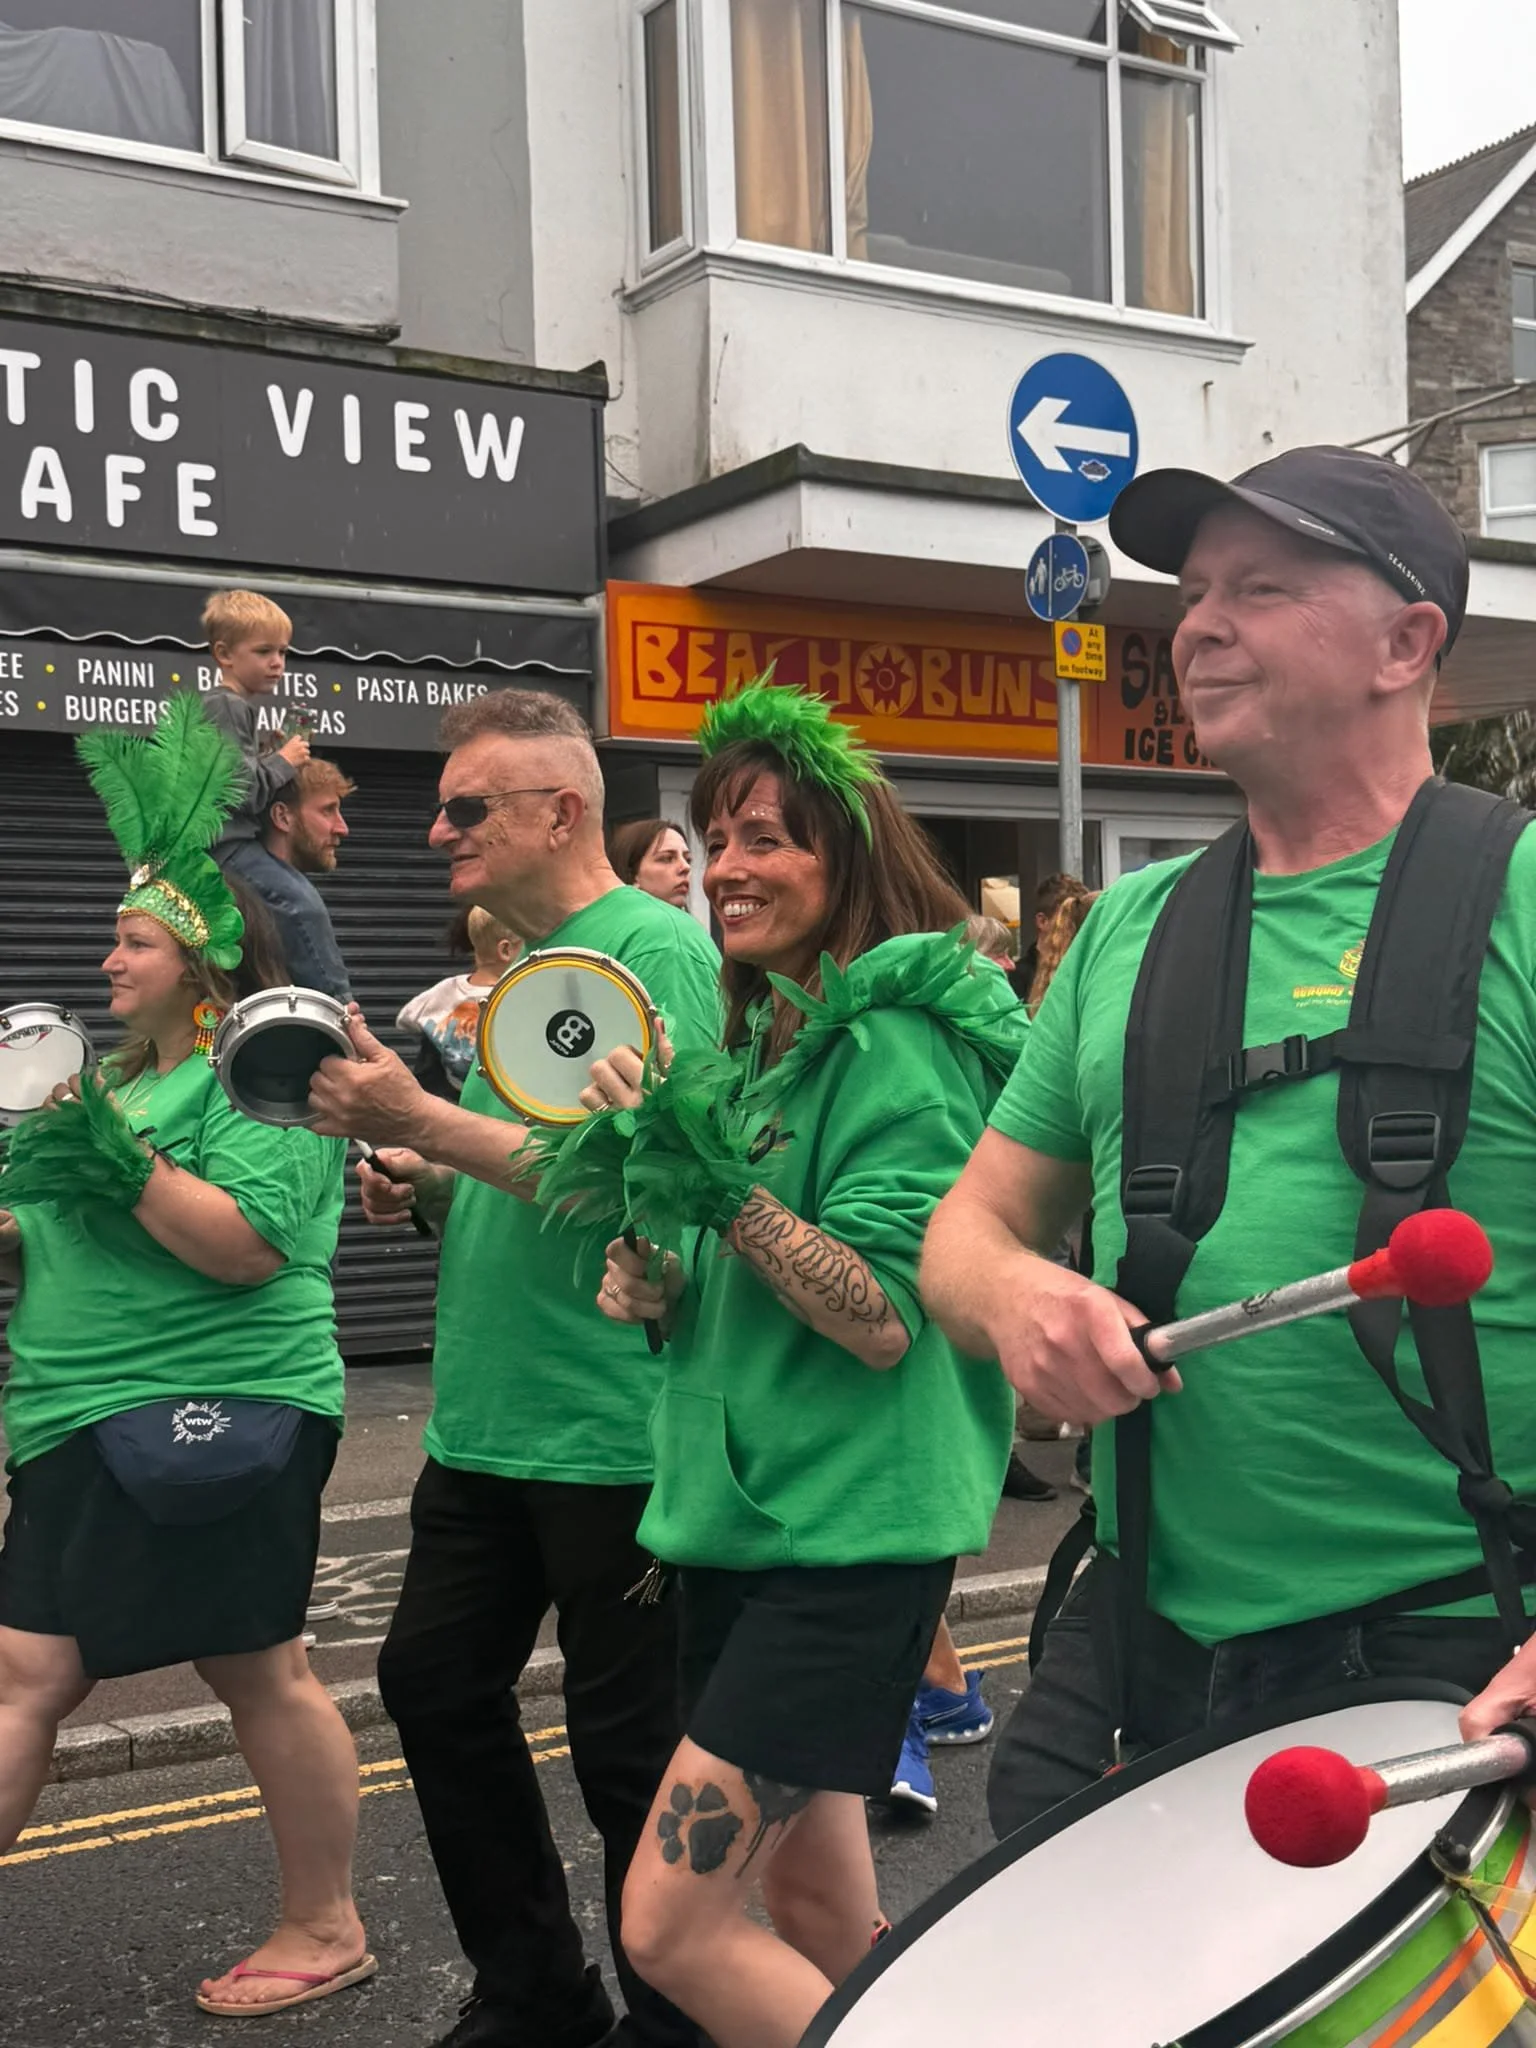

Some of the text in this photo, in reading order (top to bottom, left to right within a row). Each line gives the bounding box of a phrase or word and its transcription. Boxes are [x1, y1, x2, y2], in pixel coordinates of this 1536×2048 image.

[267, 384, 525, 482] VIEW
[21, 446, 219, 537] AFE
[78, 658, 154, 688] PANINI
[357, 676, 419, 704] PASTA
[1071, 664, 1103, 677] footway
[65, 695, 172, 725] BURGERS
[1124, 728, 1175, 766] ICE
[185, 1418, 213, 1426] wtw
